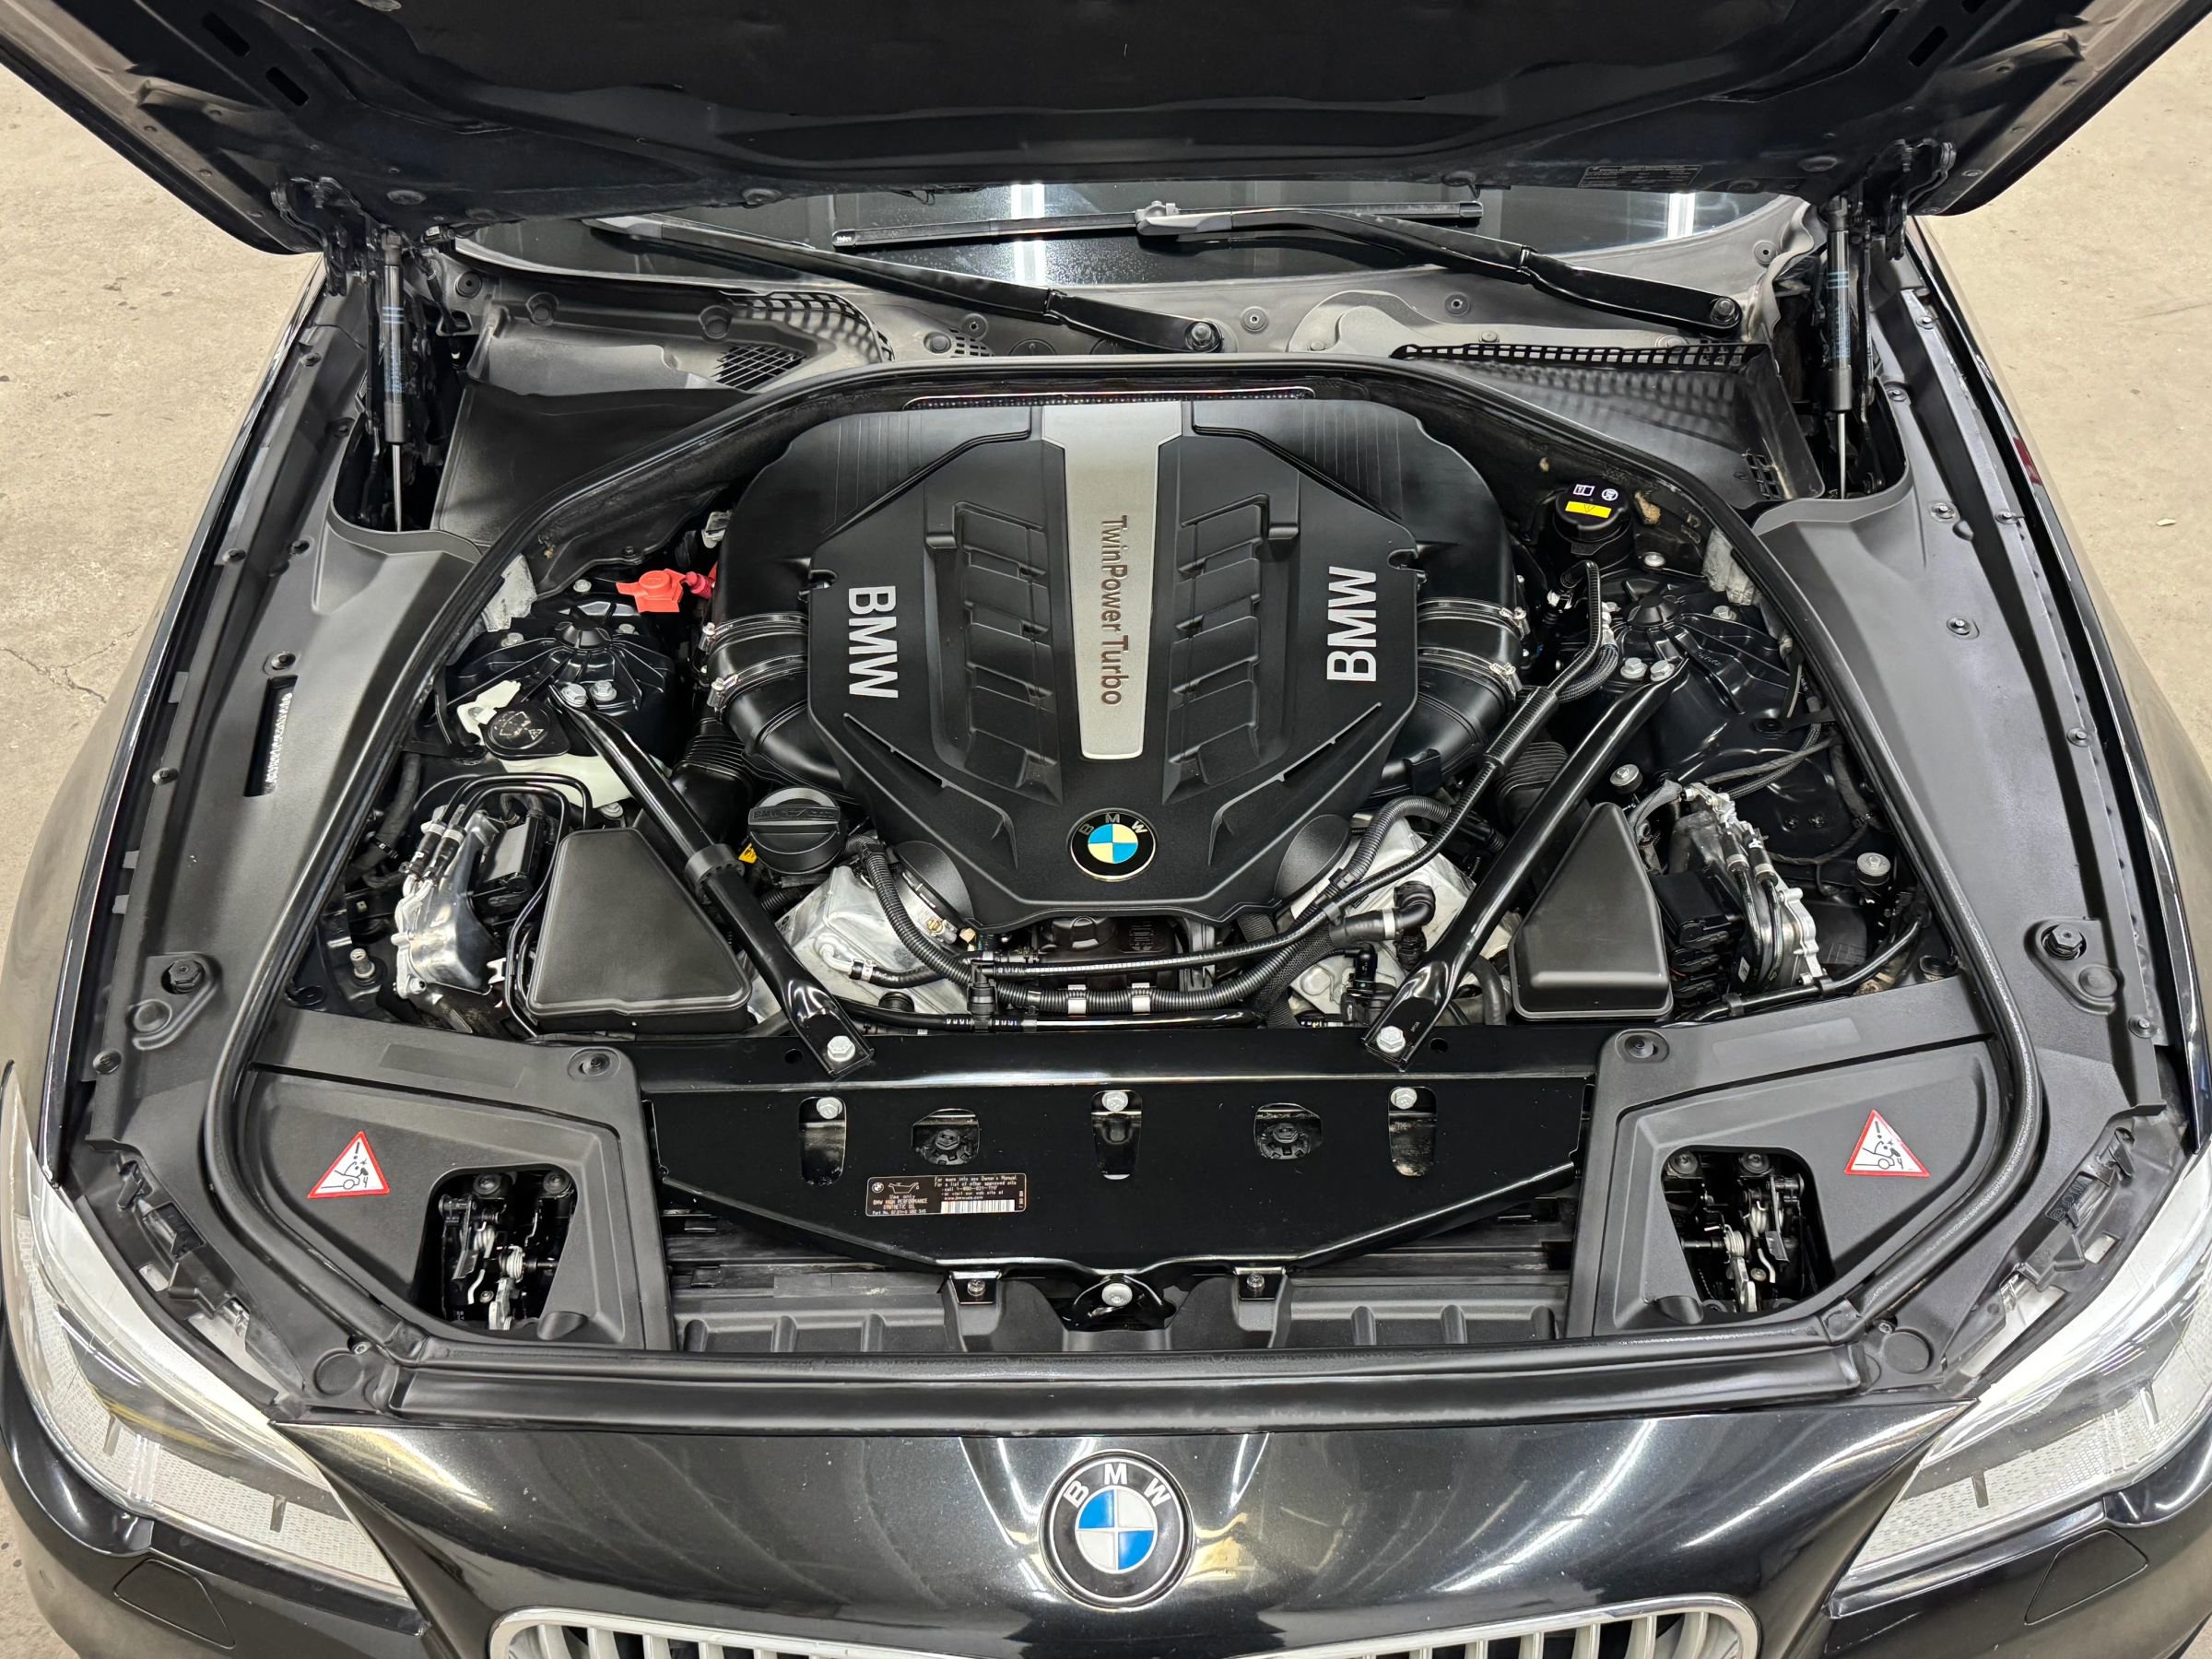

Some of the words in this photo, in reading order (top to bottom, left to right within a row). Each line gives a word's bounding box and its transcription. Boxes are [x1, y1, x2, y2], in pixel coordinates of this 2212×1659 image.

[1100, 514, 1128, 632] TwinPower
[849, 585, 899, 699] BMW
[1100, 635, 1130, 705] Turbo
[1327, 566, 1376, 682] BMW
[1078, 813, 1148, 836] BMW
[1063, 1463, 1171, 1509] BMW
